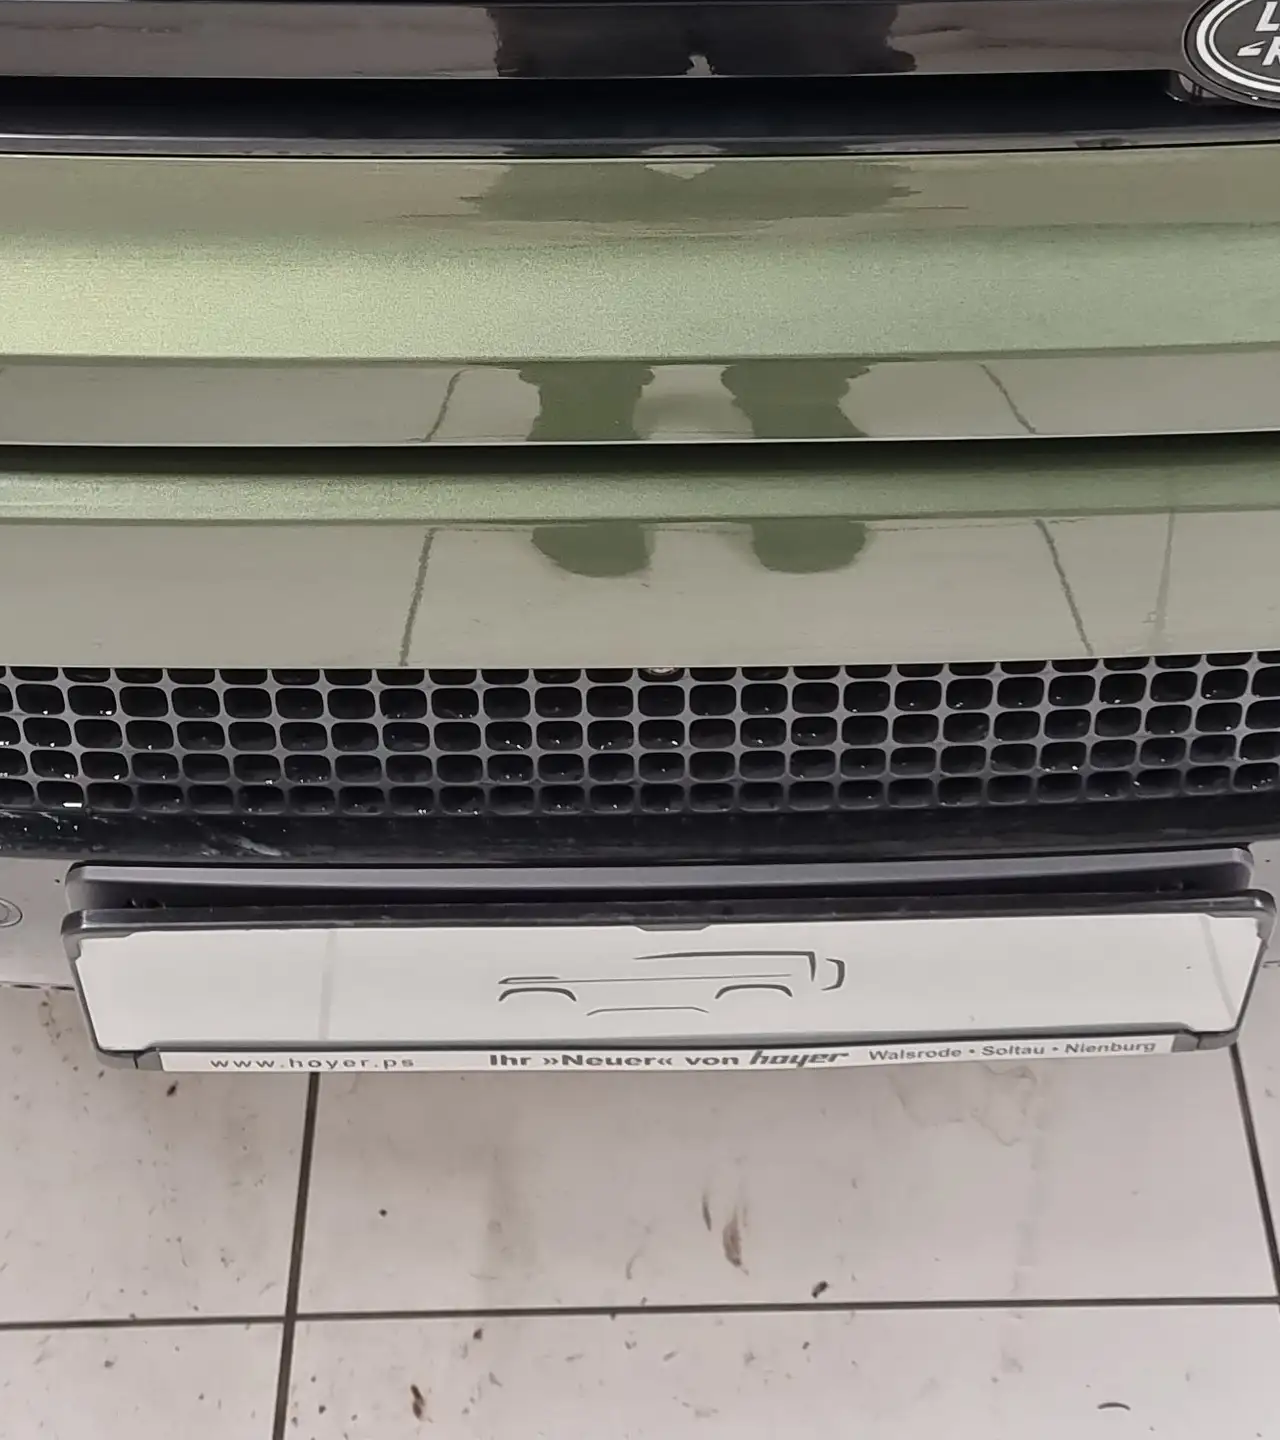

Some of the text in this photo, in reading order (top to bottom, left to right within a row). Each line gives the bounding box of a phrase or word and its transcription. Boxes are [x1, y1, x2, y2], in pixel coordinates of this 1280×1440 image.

[210, 1057, 415, 1071] www.hoyer.ps
[489, 1054, 531, 1066] Ihr
[685, 1054, 739, 1066] von
[749, 1049, 849, 1068] hoyer
[868, 1046, 962, 1061] Walsrode
[981, 1044, 1045, 1057] Soltau
[1065, 1041, 1156, 1055] Nienburg
